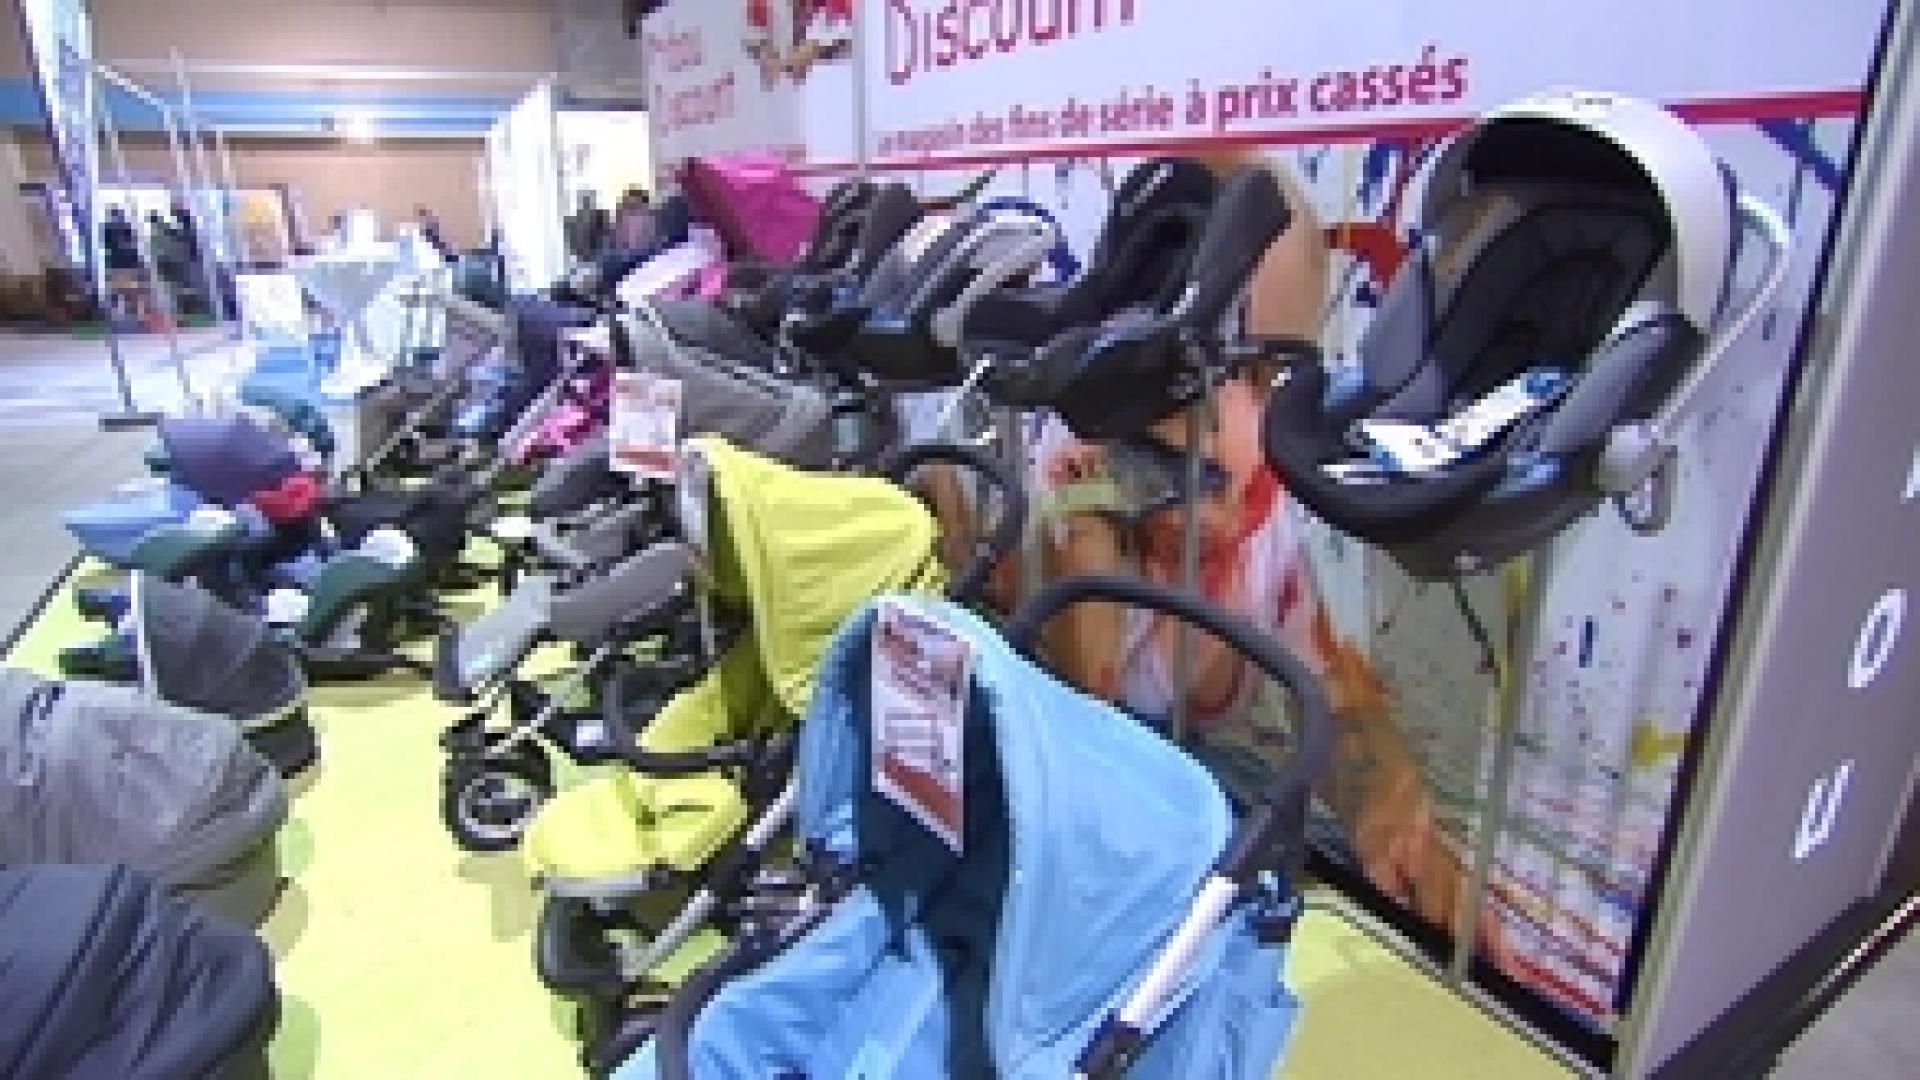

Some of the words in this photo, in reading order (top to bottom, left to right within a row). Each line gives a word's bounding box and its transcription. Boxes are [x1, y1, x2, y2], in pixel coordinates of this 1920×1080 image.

[1060, 96, 1090, 138] de
[1100, 88, 1174, 132] série
[1185, 78, 1207, 125] à
[1217, 65, 1298, 132] prix
[1310, 45, 1469, 113] cassés
